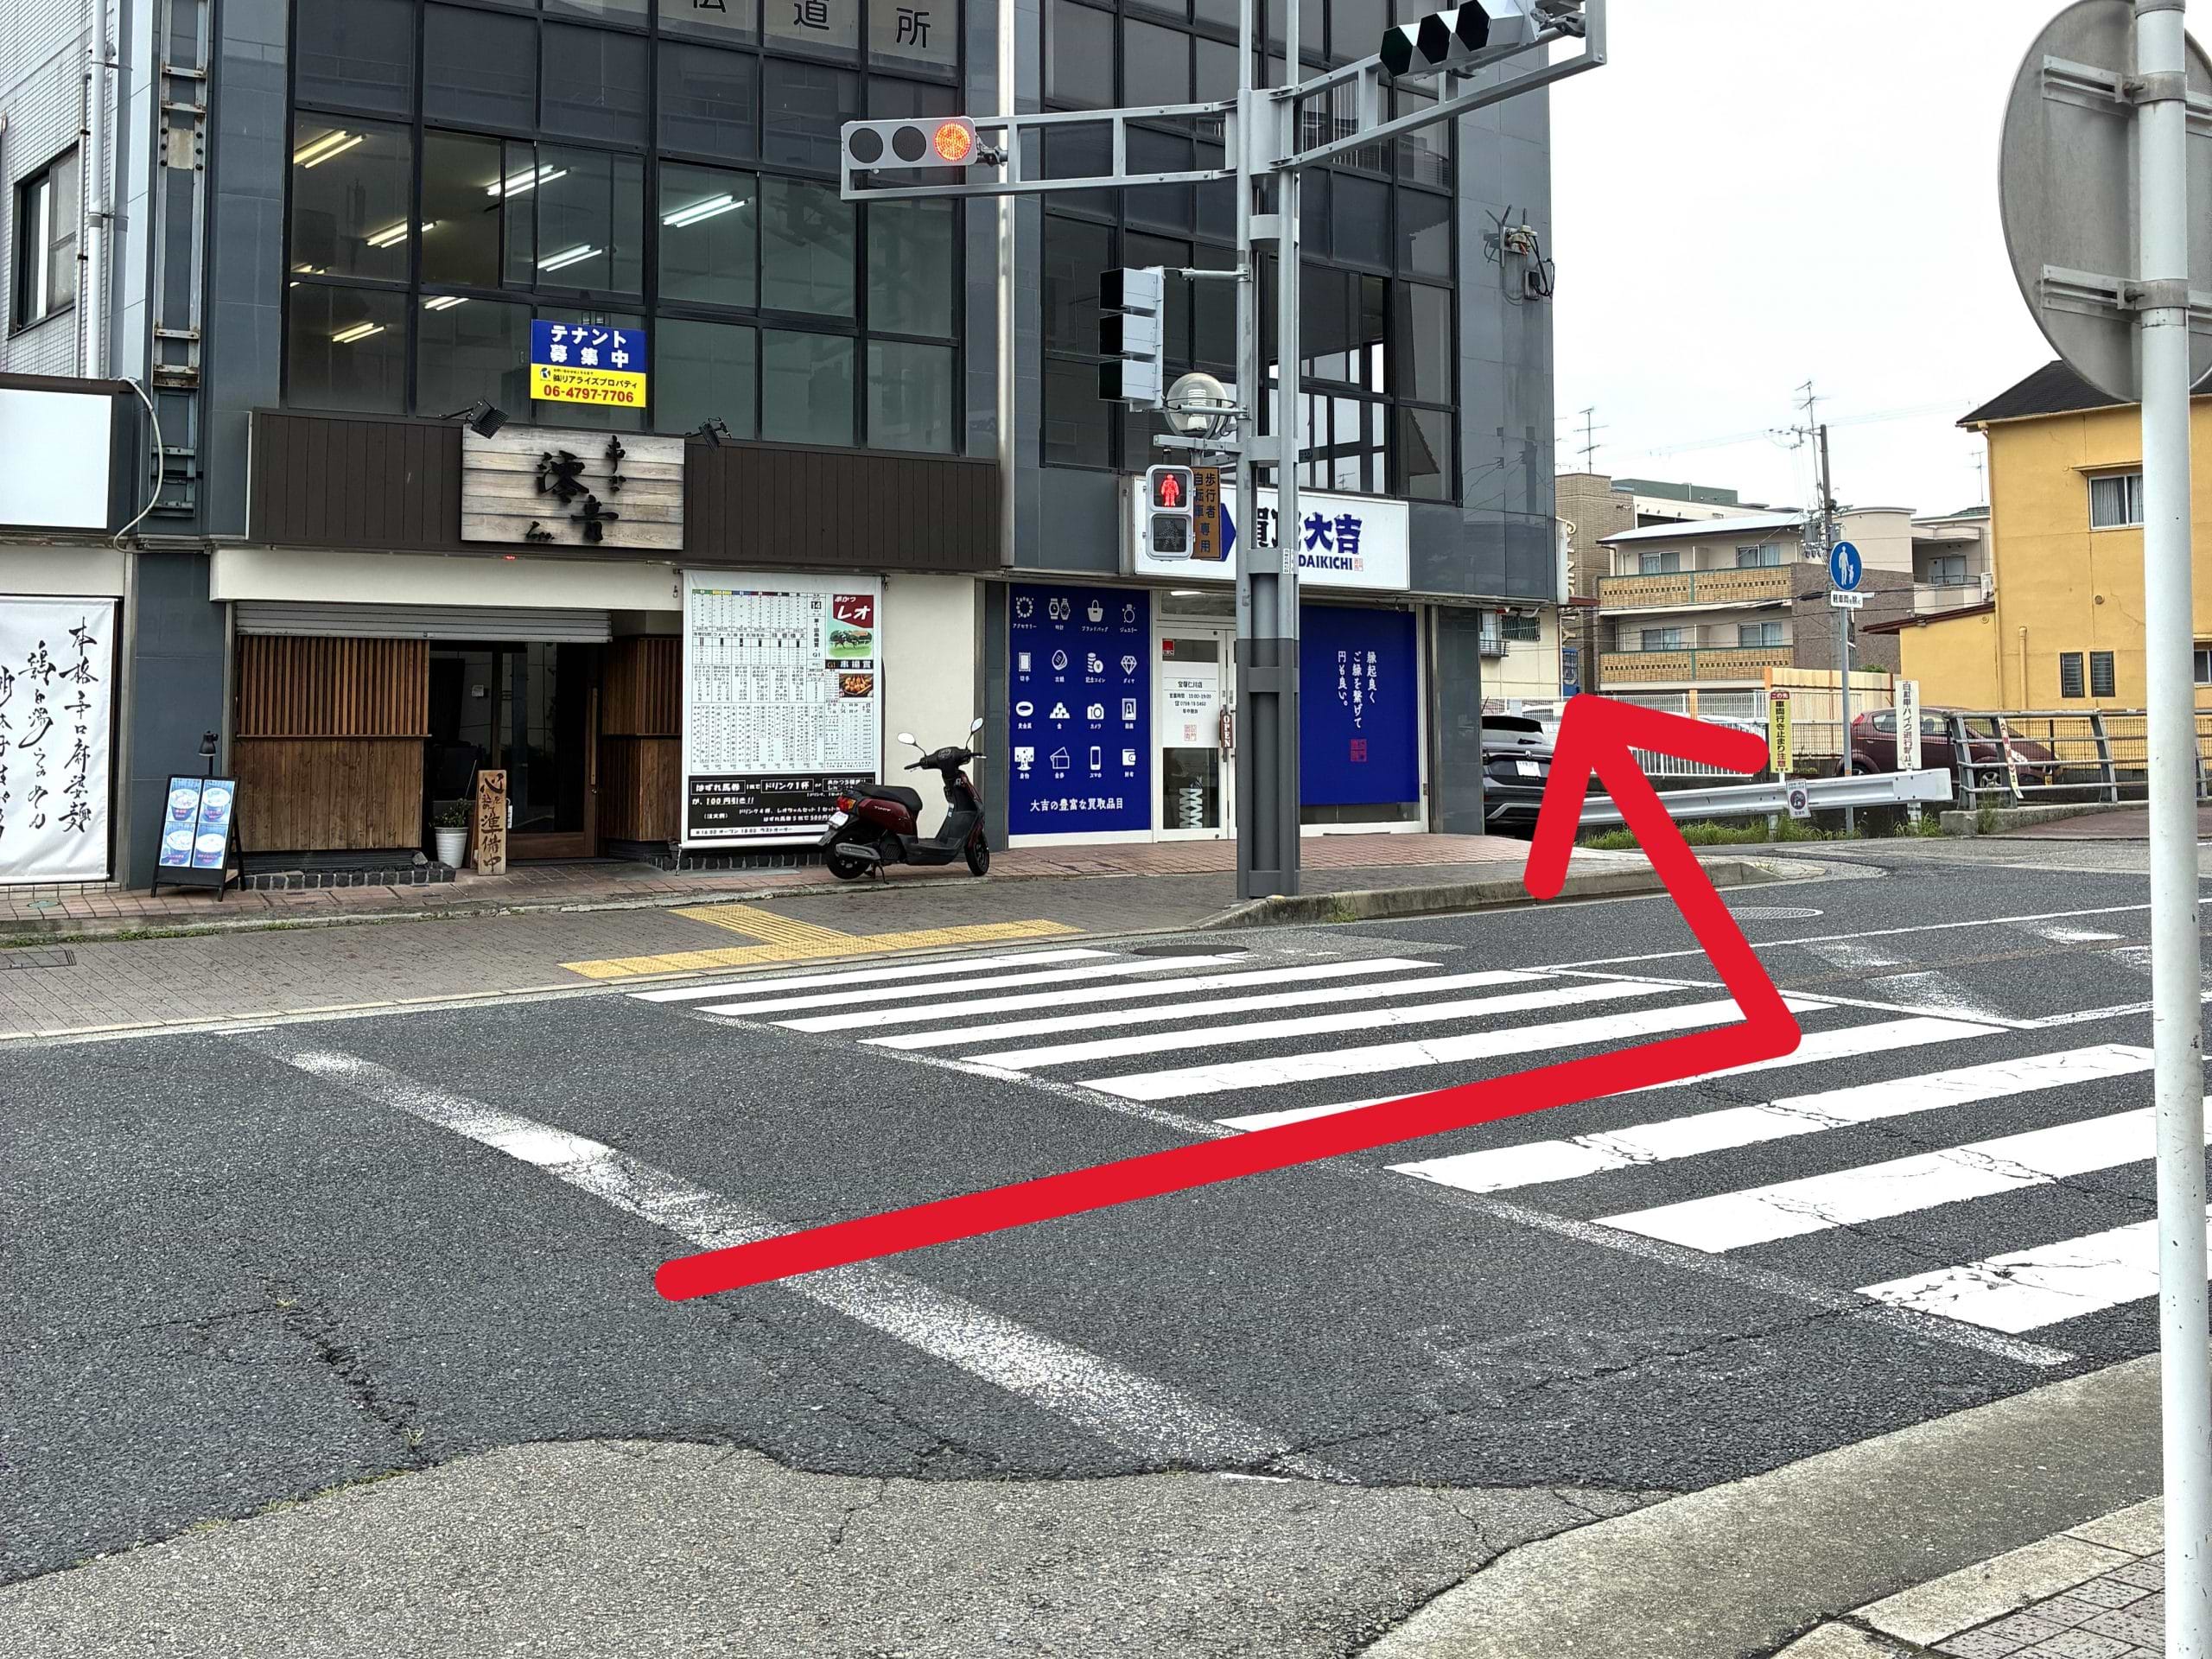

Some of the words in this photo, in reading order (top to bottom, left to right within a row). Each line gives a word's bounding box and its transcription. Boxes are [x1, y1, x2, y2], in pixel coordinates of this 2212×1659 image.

[551, 325, 626, 348] テナント
[550, 344, 629, 368] 募集中
[543, 385, 634, 403] 06-4797-7706
[1205, 473, 1216, 518] 歩行者
[1200, 522, 1211, 552] 専用
[1299, 554, 1353, 570] DAIKICHI
[837, 605, 870, 620] レオ
[1338, 651, 1348, 706] 円も良い。
[1366, 651, 1377, 703] 縁起良く
[1351, 651, 1363, 728] ご縁を繋げて
[1776, 701, 1786, 767] 車両行き止まり注意
[696, 783, 741, 792] はずれ馬券
[765, 781, 810, 791] ドリンク1杯
[1030, 798, 1123, 812] 大吉の豊富な買取品目
